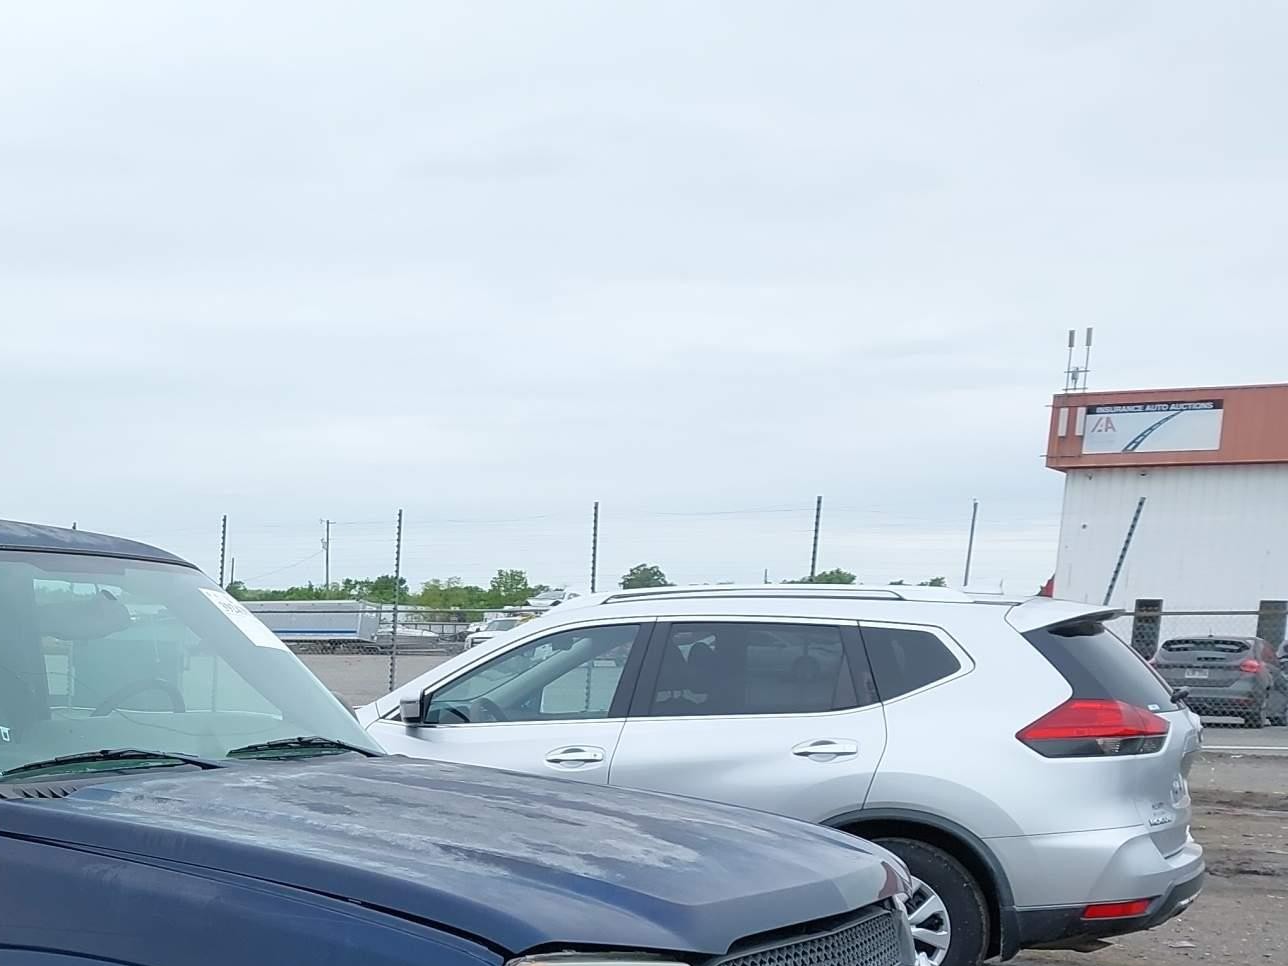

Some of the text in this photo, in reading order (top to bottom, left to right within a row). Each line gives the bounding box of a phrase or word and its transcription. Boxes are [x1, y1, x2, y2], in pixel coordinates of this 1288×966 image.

[1096, 402, 1214, 414] INSURANCE AUTO AUCTIONS
